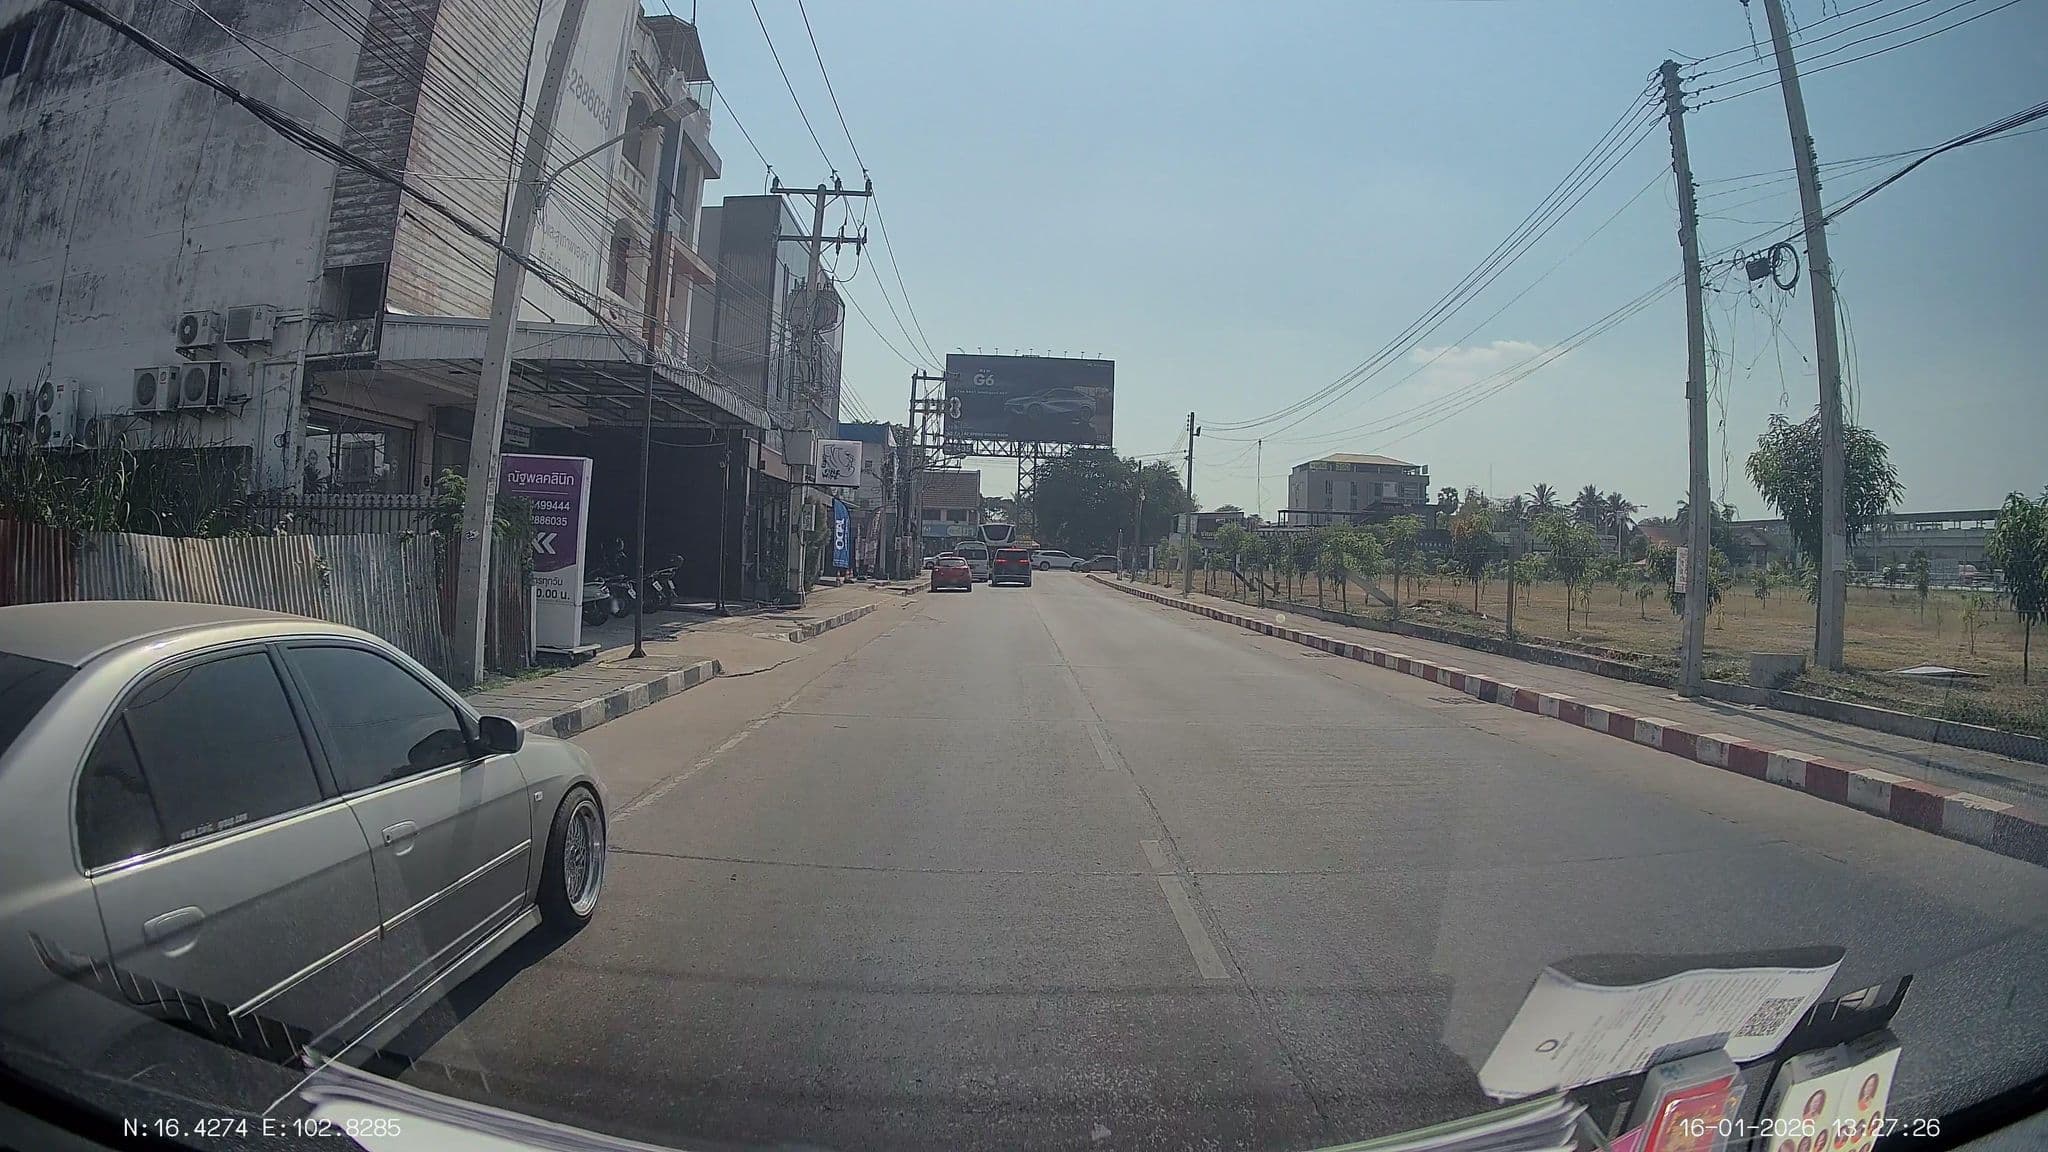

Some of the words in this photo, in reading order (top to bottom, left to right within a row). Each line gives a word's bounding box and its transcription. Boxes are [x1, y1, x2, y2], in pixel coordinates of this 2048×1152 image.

[973, 373, 994, 386] G6
[507, 470, 575, 486] ณัฐพลคลินิก
[536, 588, 557, 599] 0.00
[560, 591, 570, 600] น.
